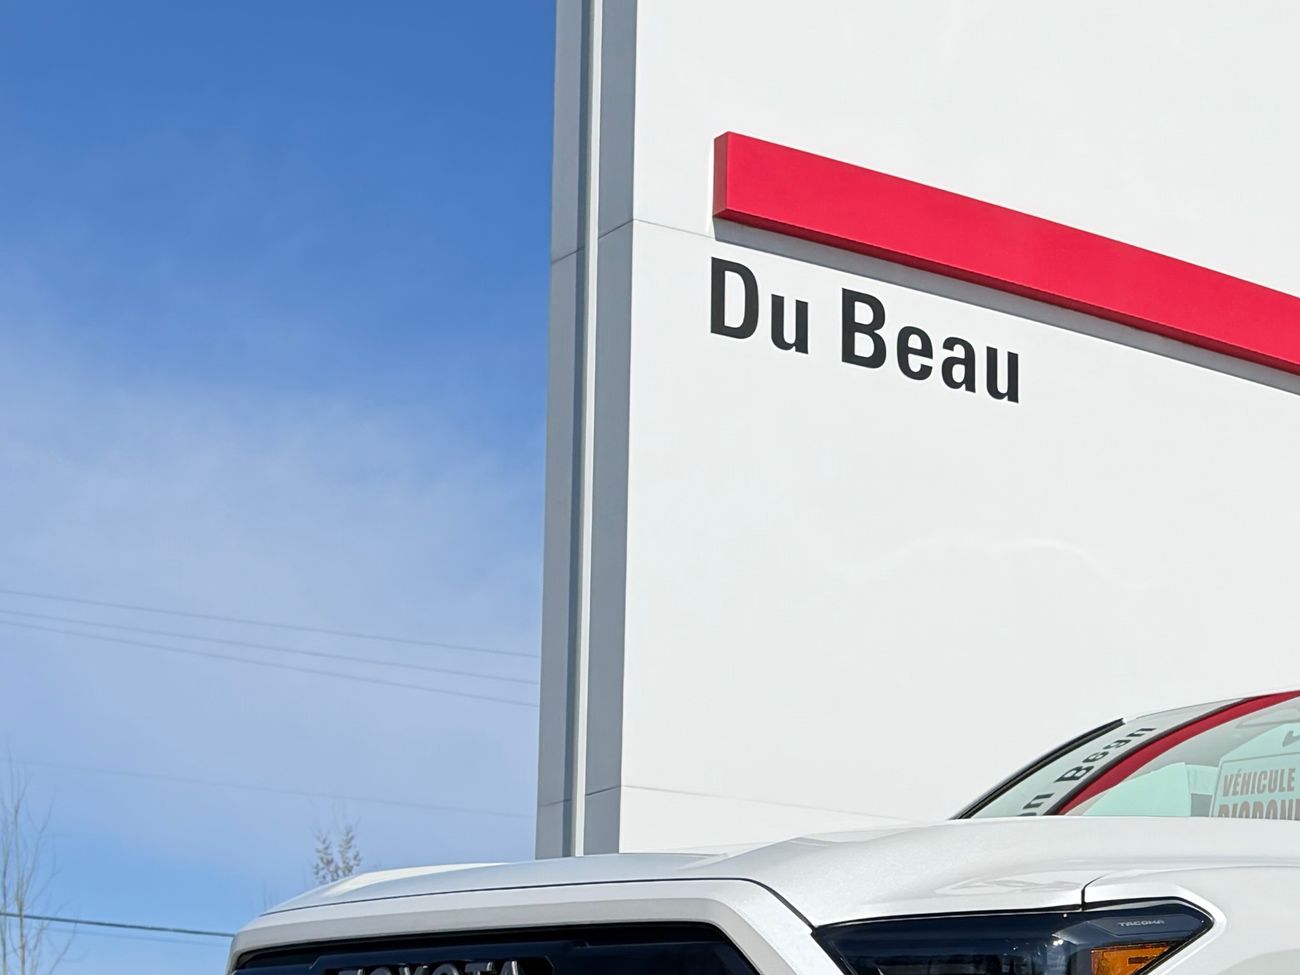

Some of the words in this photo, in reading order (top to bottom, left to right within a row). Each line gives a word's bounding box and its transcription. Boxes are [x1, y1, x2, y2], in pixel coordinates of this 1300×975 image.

[710, 256, 809, 354] Du
[842, 287, 1019, 403] Beau
[1222, 767, 1296, 797] VÉHICULE
